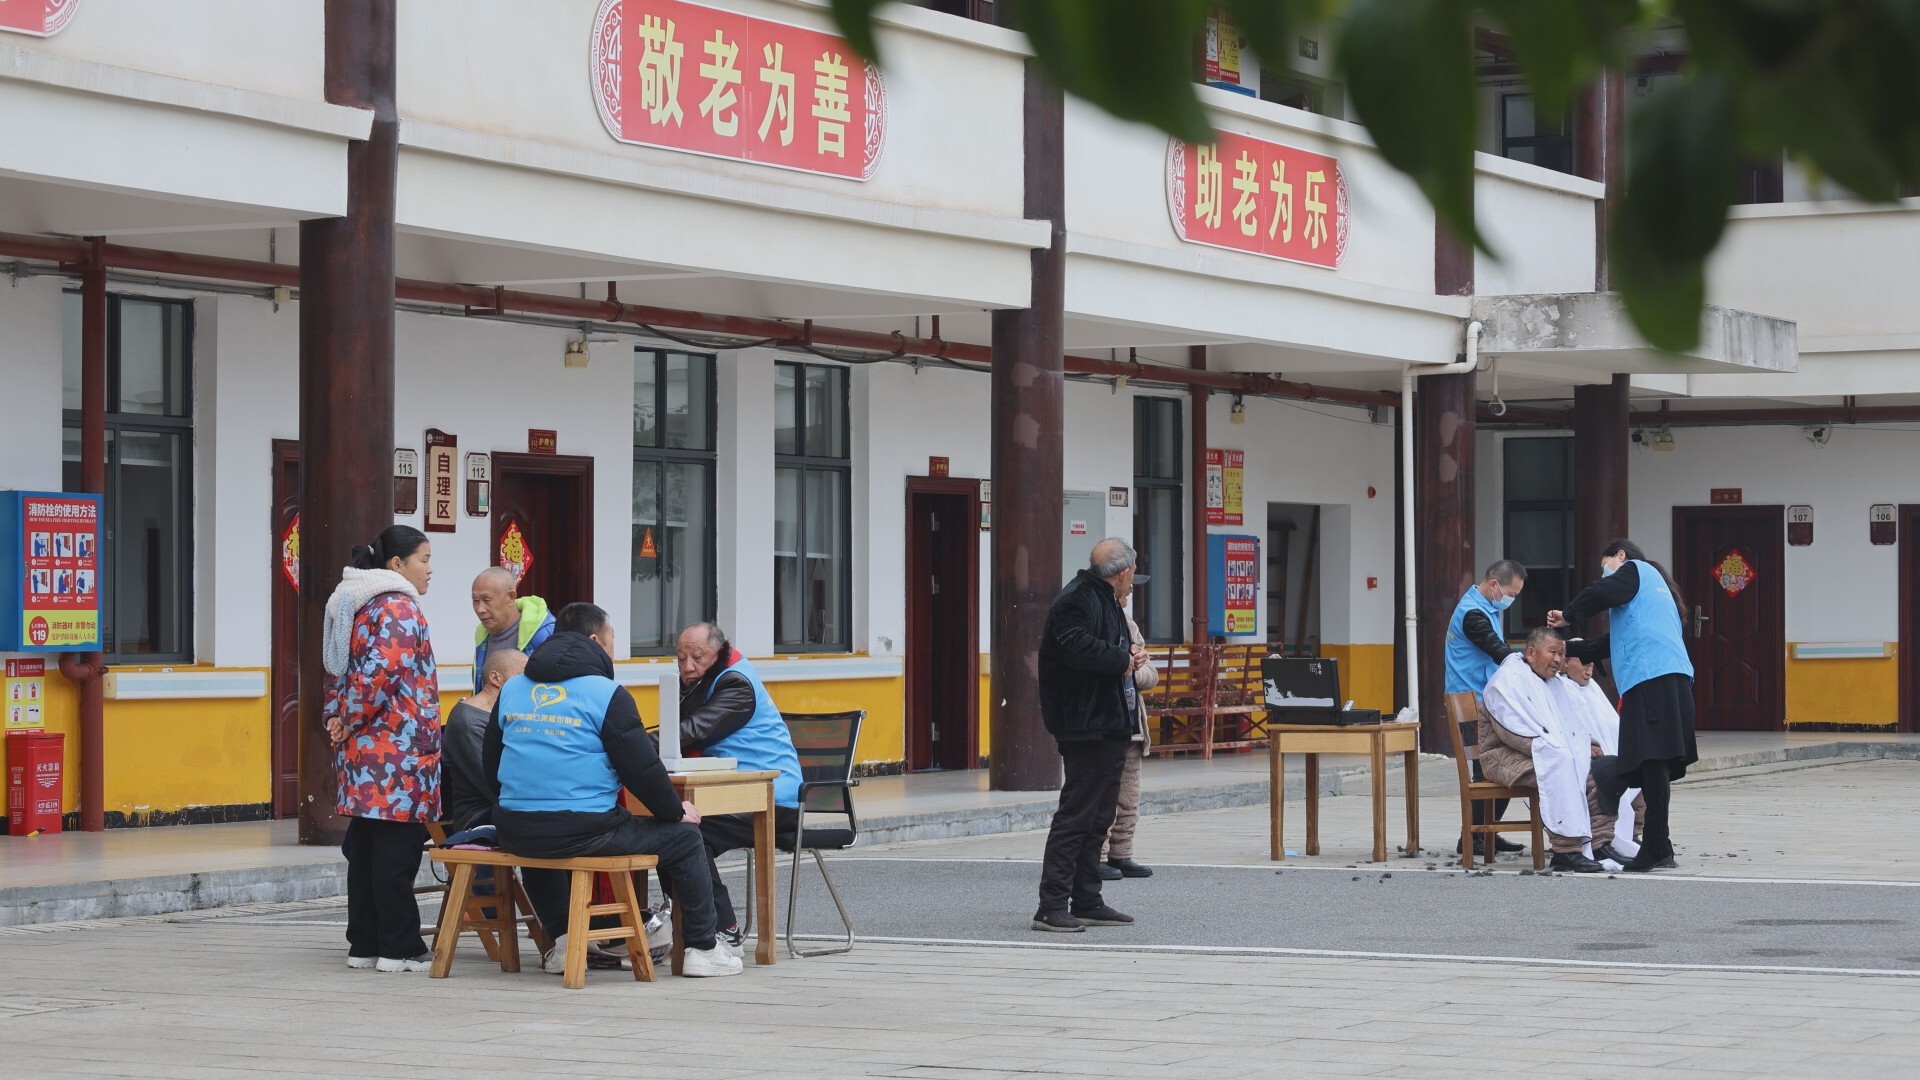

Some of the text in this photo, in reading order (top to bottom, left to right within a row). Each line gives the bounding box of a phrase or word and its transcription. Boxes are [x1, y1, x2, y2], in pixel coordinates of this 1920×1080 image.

[639, 14, 851, 158] 敬老为善
[1195, 142, 1327, 249] 助老为乐
[398, 463, 413, 475] 113
[472, 467, 485, 478] 112
[437, 453, 450, 519] 自理区
[28, 502, 97, 518] 消防栓的使用方法
[1876, 513, 1891, 521] 106
[1793, 514, 1808, 522] 107
[502, 531, 523, 563] 福
[1721, 553, 1745, 577] 福
[32, 629, 46, 640] 119
[36, 762, 60, 772] 灭火器箱
